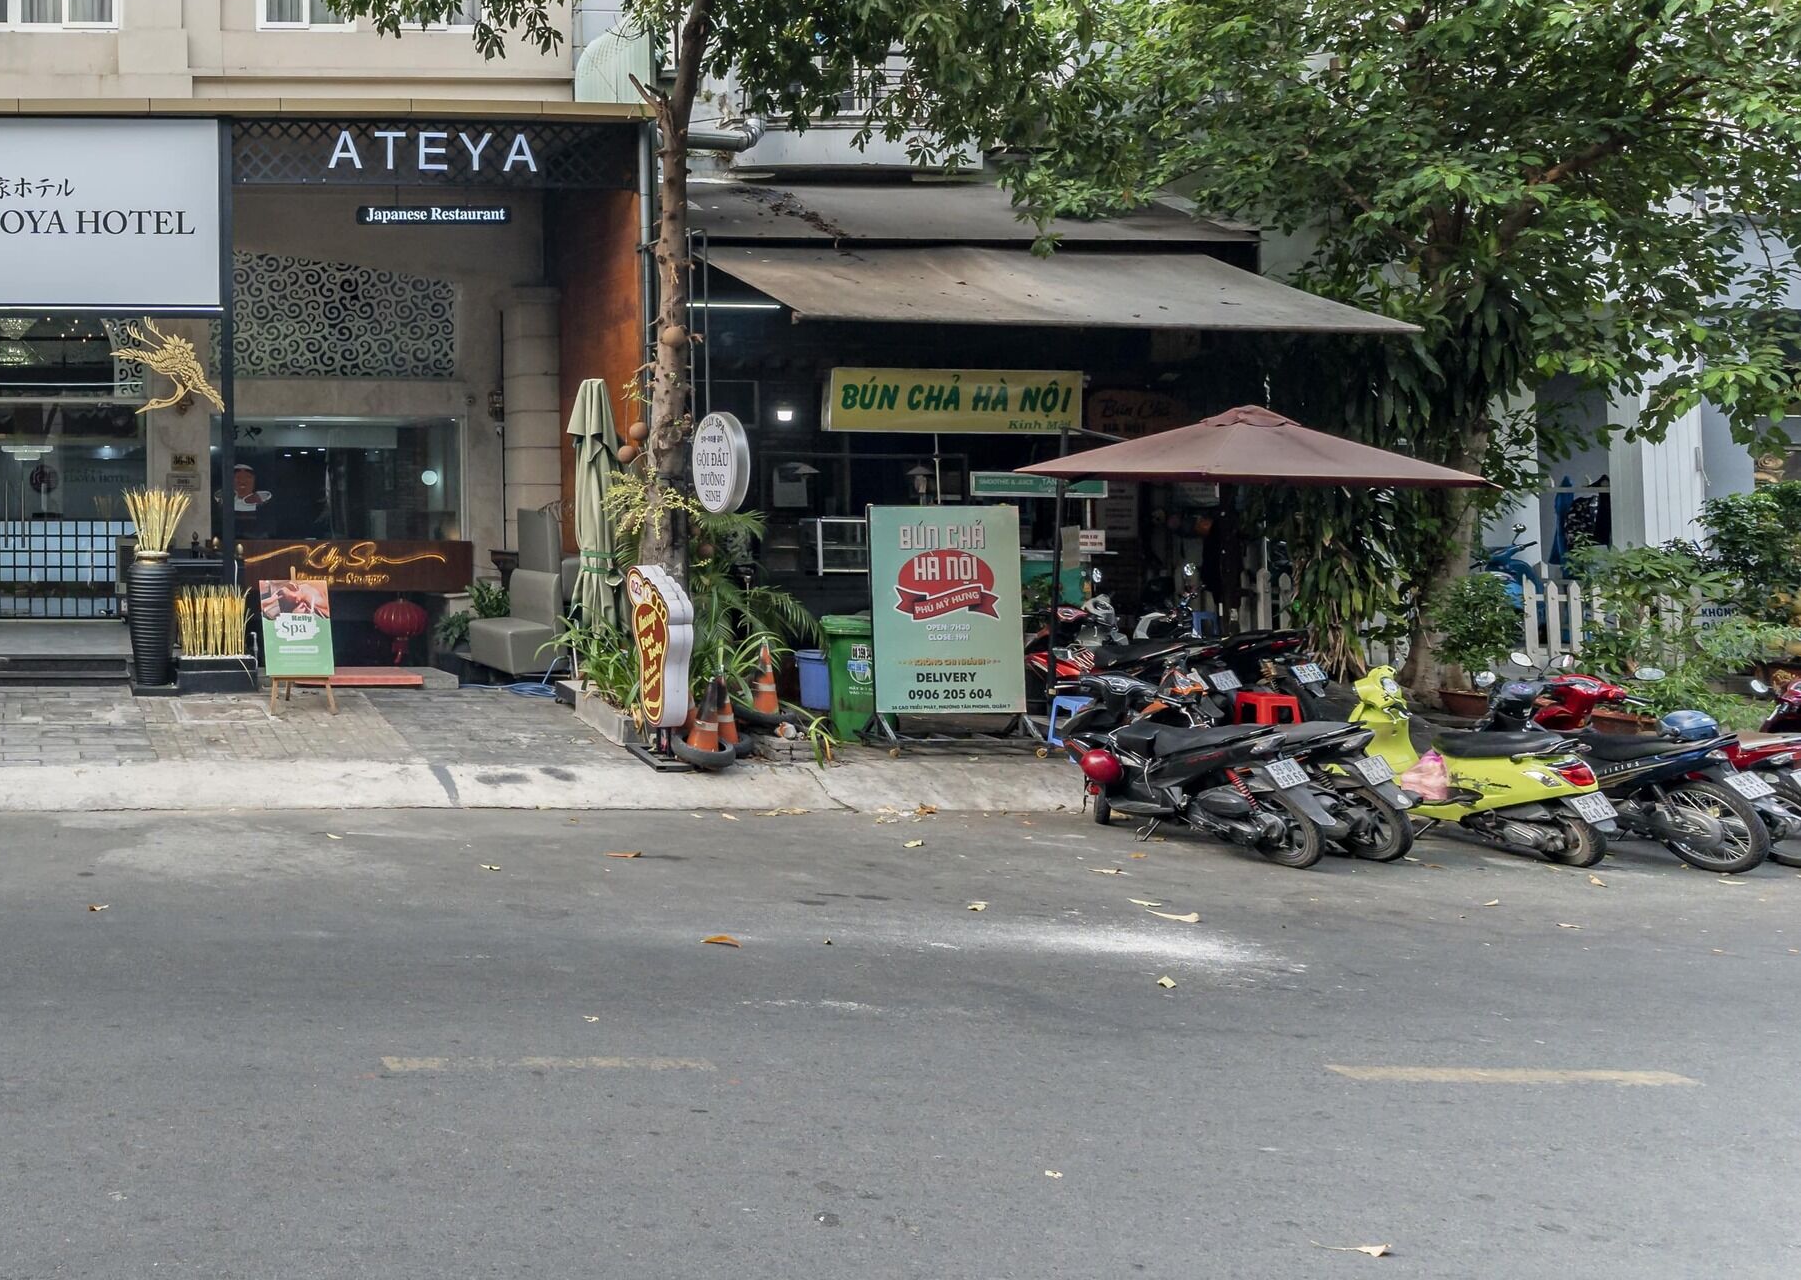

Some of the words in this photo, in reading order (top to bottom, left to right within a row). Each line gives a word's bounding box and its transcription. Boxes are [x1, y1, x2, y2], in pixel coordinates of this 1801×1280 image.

[327, 130, 538, 172] ATEYA
[75, 208, 197, 236] HOTEL
[365, 207, 428, 224] Japanese
[430, 206, 506, 222] Restaurant
[841, 376, 900, 411] BÚN
[907, 374, 961, 412] CHẢ
[971, 378, 1008, 412] HÀ
[1019, 380, 1073, 418] NỘI
[704, 490, 722, 503] SINH
[898, 520, 940, 550] BÚN
[945, 519, 986, 550] CHẢ
[304, 541, 344, 573] Kelly
[913, 551, 940, 581] HÀ
[945, 552, 978, 585] NỘI
[914, 600, 935, 615] PHÚ
[935, 597, 950, 610] MỸ
[950, 591, 980, 605] HƯNG
[291, 614, 312, 624] Kelly
[638, 609, 657, 633] Massage
[950, 623, 972, 632] 7H30
[280, 620, 307, 637] Spa
[640, 633, 655, 650] Foot
[647, 642, 663, 661] Body
[916, 671, 977, 683] DELIVERY
[908, 689, 940, 700] 0906
[943, 689, 966, 700] 205
[969, 688, 993, 699] 604
[1603, 760, 1640, 775] SIRIUS
